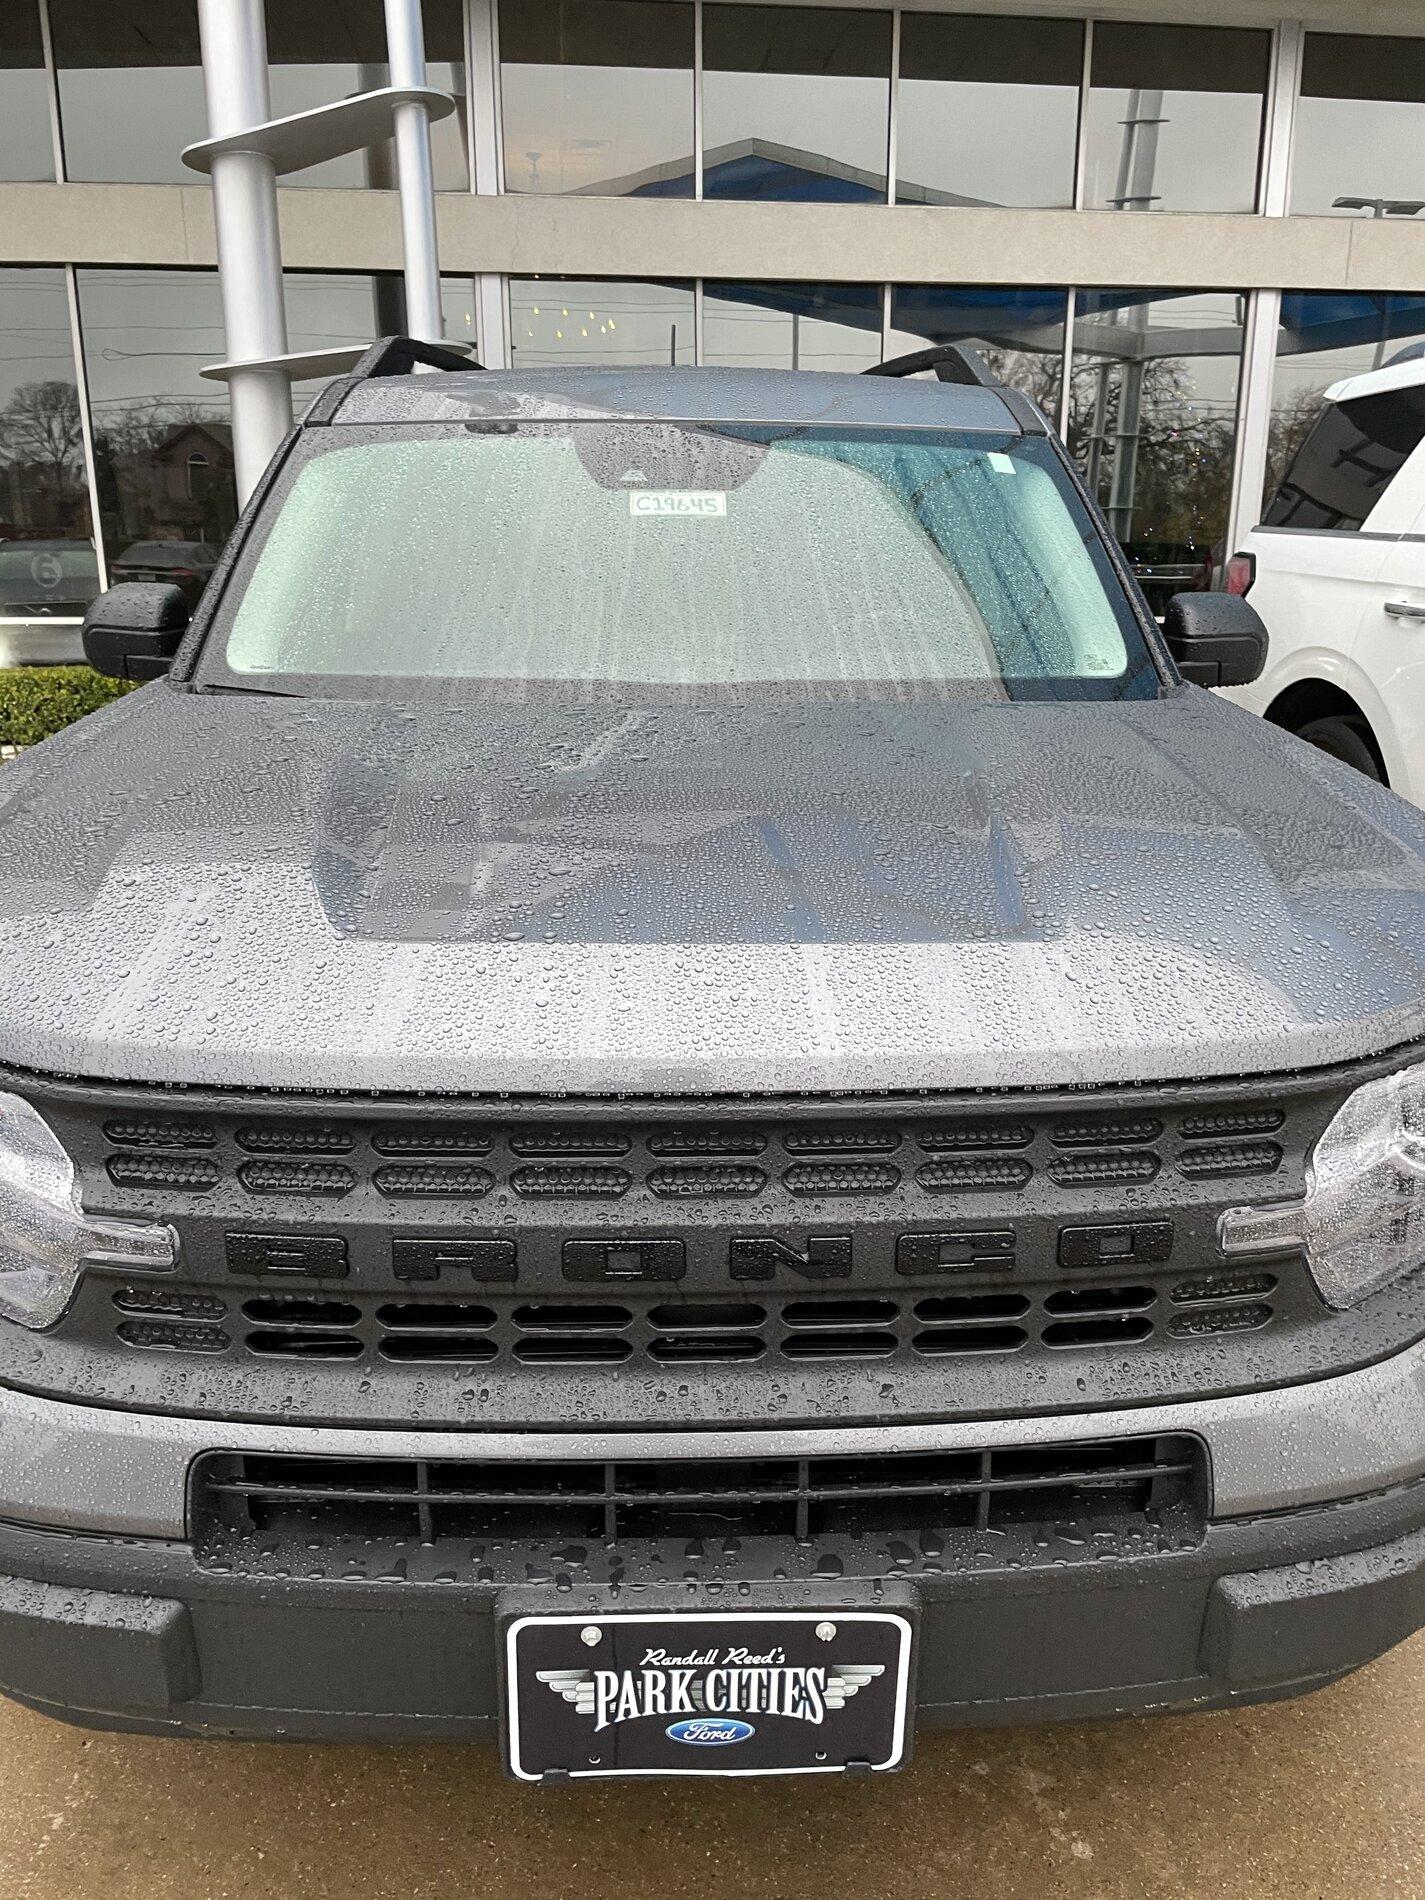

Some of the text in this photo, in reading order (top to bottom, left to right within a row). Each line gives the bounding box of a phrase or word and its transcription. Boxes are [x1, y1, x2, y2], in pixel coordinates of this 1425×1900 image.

[637, 497, 718, 512] C19645
[225, 1220, 1174, 1282] BRONCO
[639, 1647, 786, 1666] Randall Reed's
[594, 1667, 825, 1732] PARK CITIES
[683, 1722, 737, 1741] Ford
